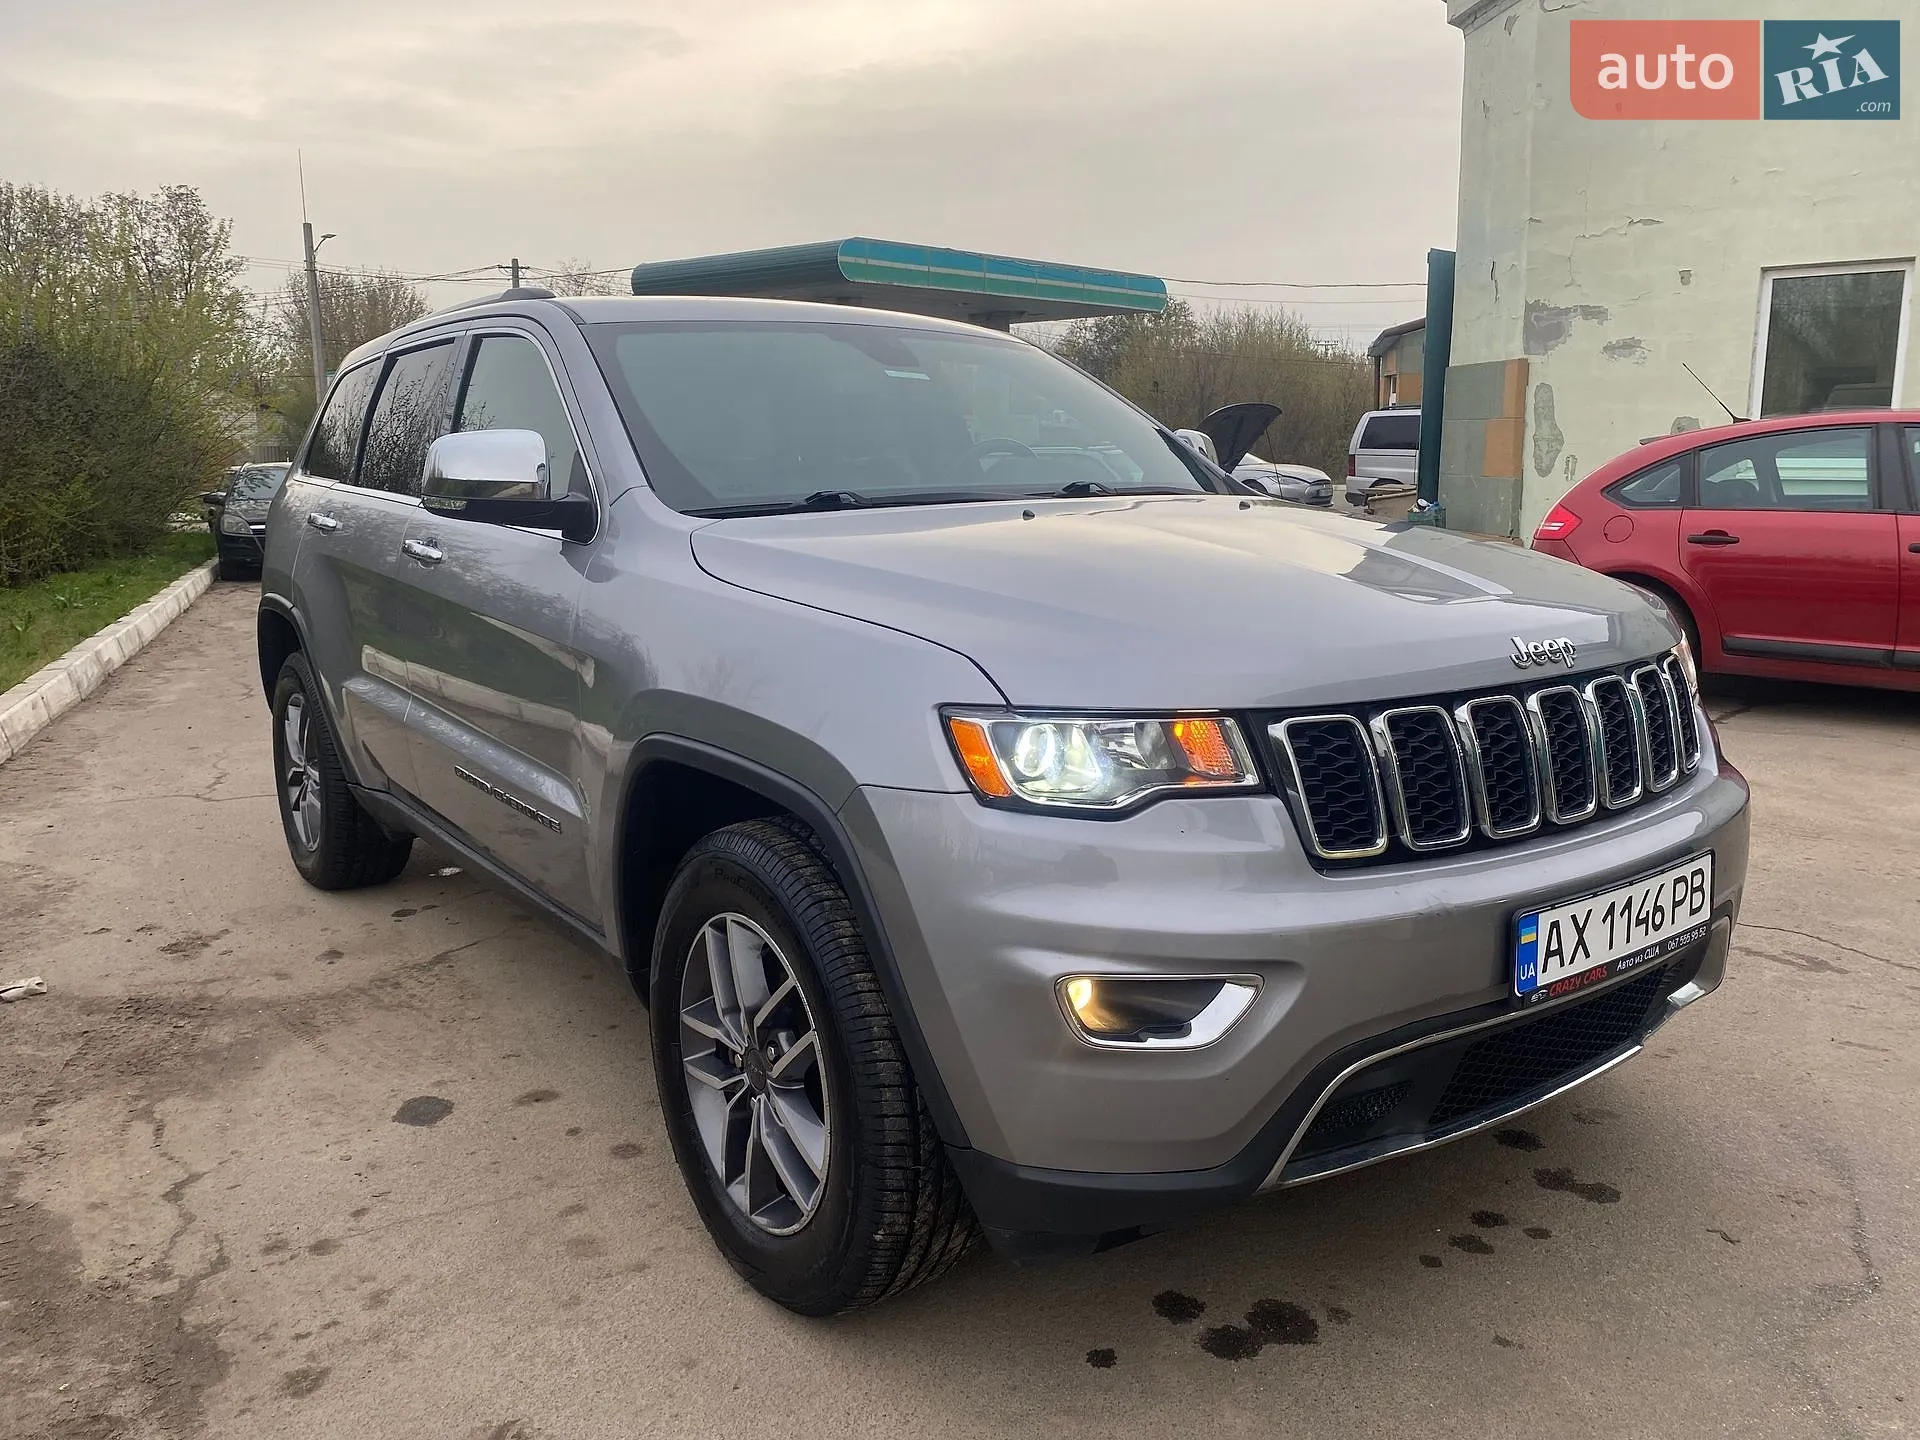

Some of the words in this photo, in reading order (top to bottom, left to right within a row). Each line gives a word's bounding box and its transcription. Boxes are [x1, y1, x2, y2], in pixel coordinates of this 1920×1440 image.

[1509, 635, 1576, 669] Jeep
[1542, 908, 1593, 974] AX
[1601, 882, 1665, 951] 1146
[1671, 867, 1705, 926] PB
[1520, 961, 1536, 981] UA
[1616, 958, 1634, 972] Авто
[1634, 954, 1643, 965] из
[1644, 945, 1659, 960] США
[1549, 976, 1581, 997] CRAZY
[1583, 965, 1609, 985] CARS
